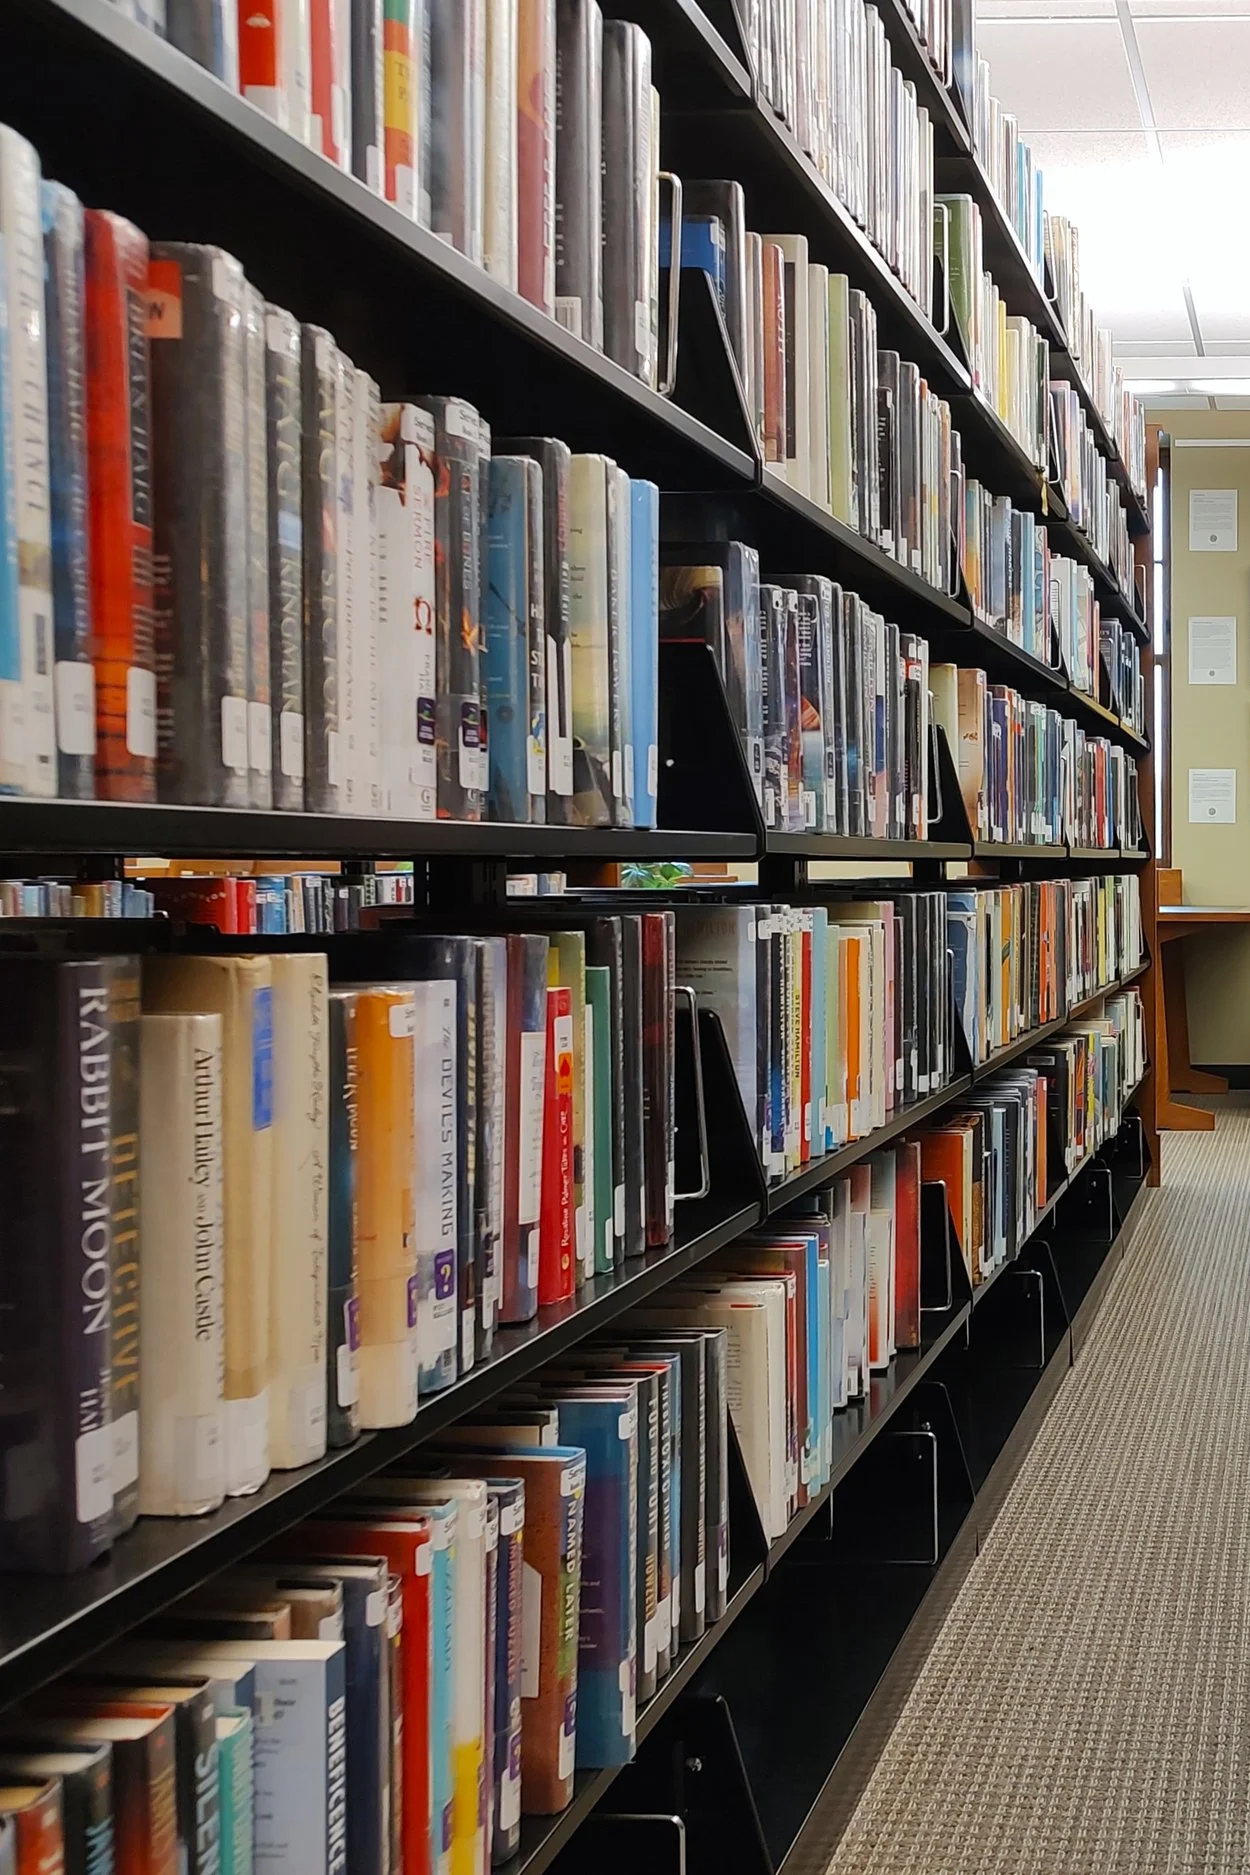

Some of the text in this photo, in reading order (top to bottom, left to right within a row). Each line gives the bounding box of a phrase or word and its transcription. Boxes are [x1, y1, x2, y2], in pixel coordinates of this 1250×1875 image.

[794, 993, 802, 1079] STEVE HAMILTON
[440, 1058, 456, 1143] DEVIL'S
[80, 986, 112, 1335] RABBIT MOON
[188, 1046, 217, 1342] Arthur Hailey John Castle
[440, 1152, 456, 1236] MAKING
[563, 1500, 578, 1641] NAMED LATER
[644, 1551, 656, 1619] HOWZELL
[327, 1696, 346, 1875] BENEFICENCE
